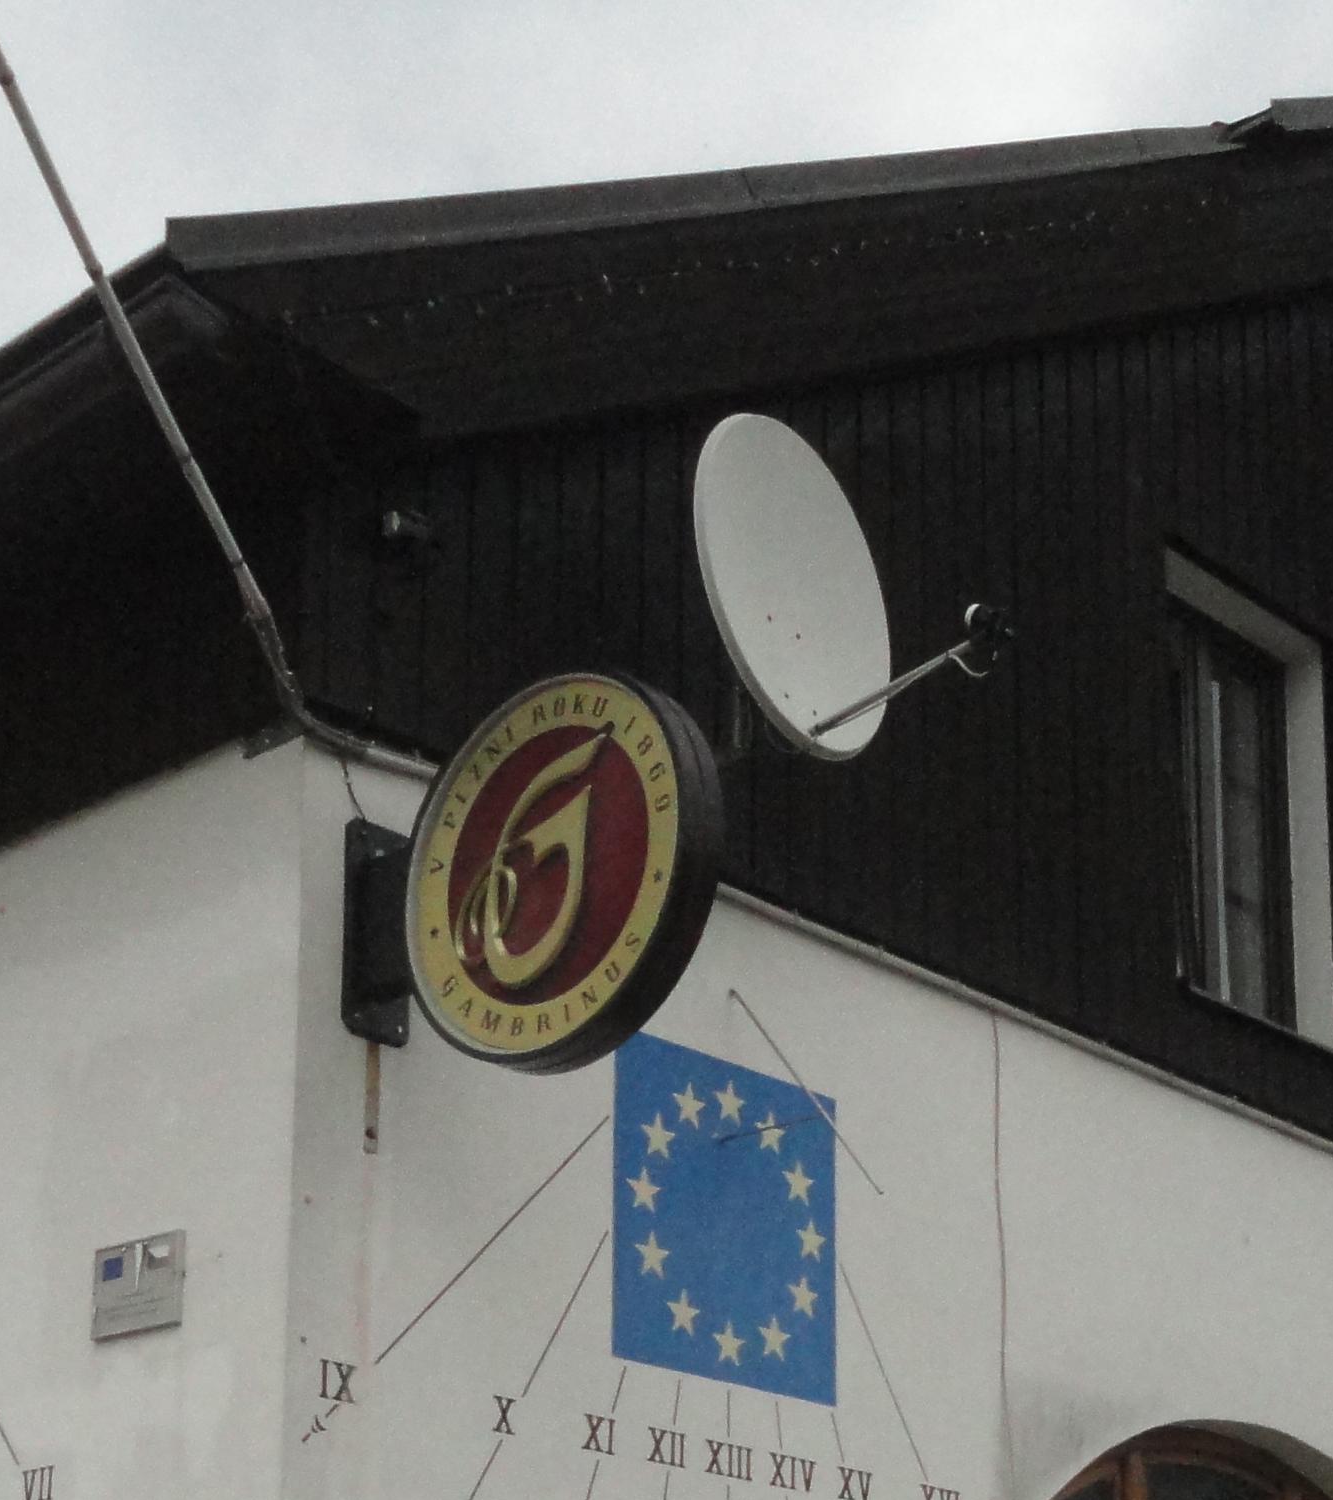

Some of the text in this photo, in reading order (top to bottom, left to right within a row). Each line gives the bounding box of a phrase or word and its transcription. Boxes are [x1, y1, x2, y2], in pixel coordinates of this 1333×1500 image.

[429, 856, 444, 874] V
[532, 694, 608, 725] ROKU
[624, 716, 670, 813] 1869
[442, 931, 642, 1036] GAMBRINUS
[320, 1358, 357, 1404] IX
[492, 1395, 516, 1436] X
[581, 1413, 616, 1456] XI
[647, 1426, 686, 1469] XII
[705, 1439, 753, 1483] XIII
[769, 1451, 817, 1494] XIV
